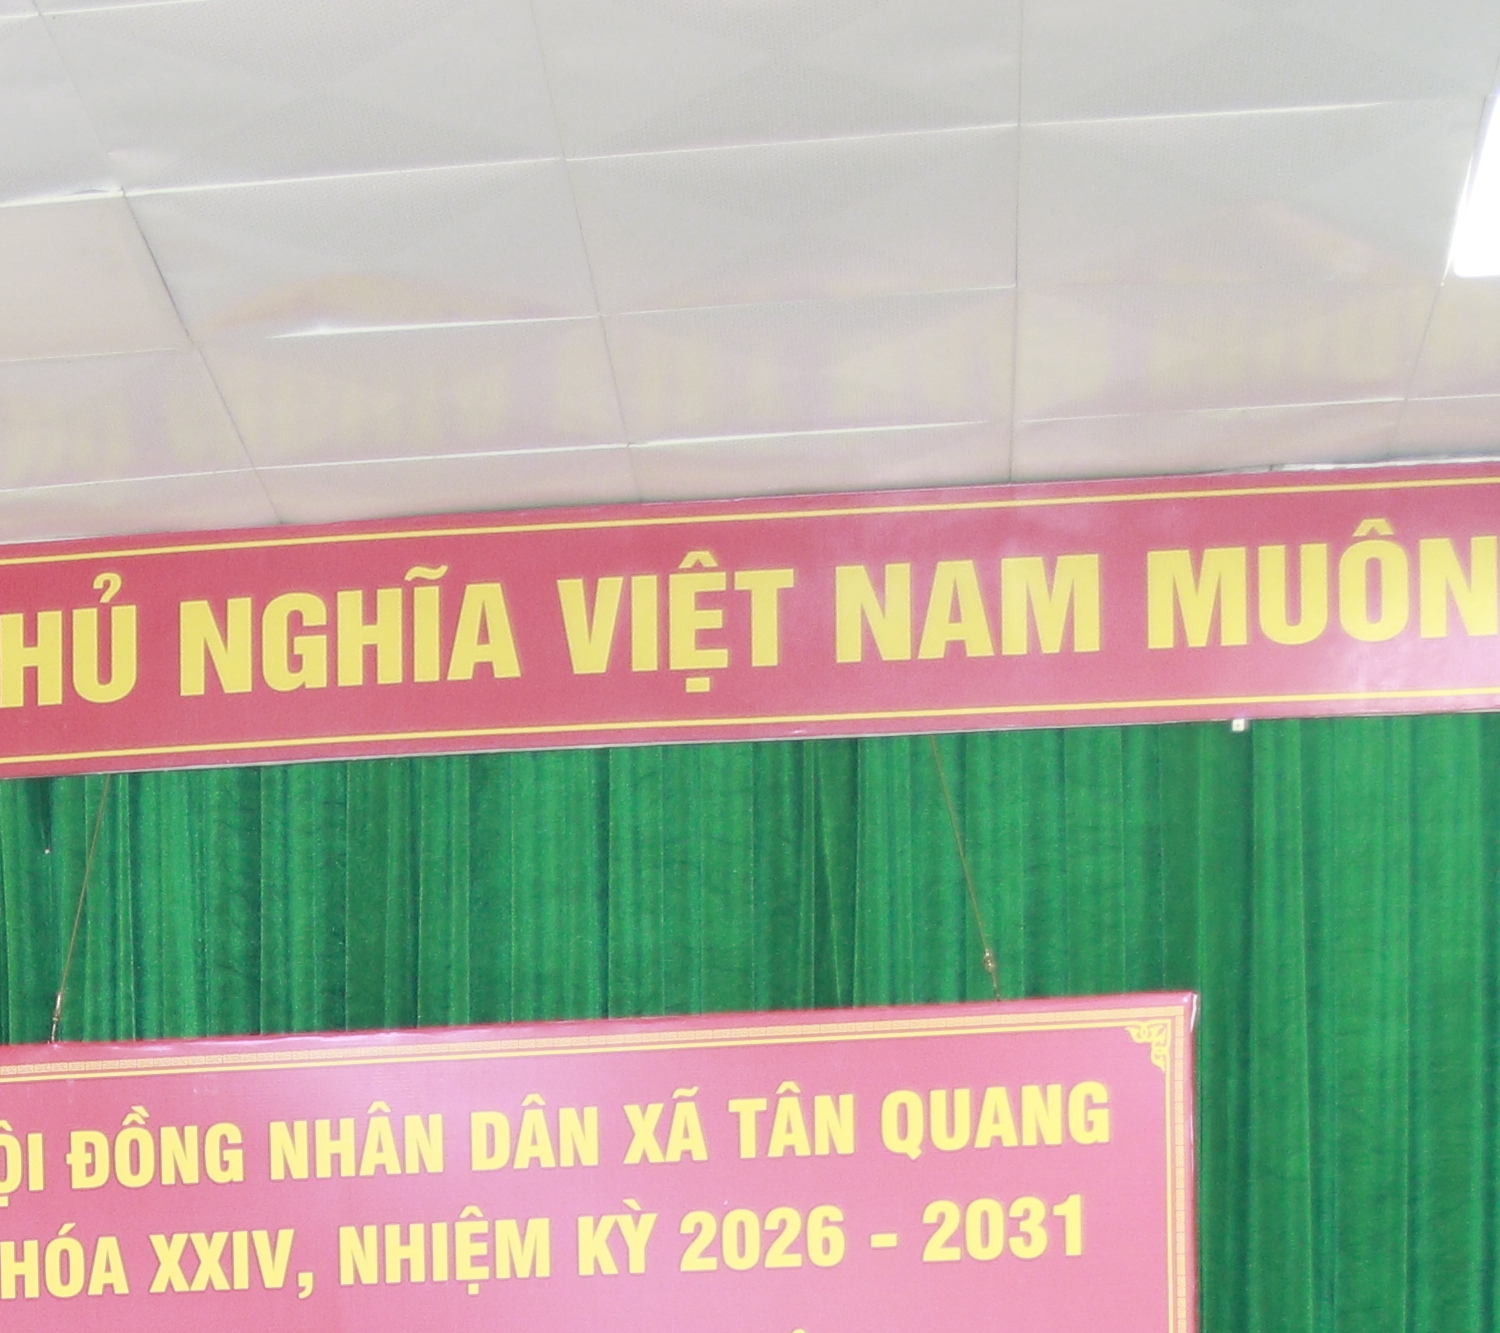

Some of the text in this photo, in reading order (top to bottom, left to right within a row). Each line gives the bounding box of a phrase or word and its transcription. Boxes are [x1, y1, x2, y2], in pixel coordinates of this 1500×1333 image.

[179, 565, 522, 696] NGHĨA
[557, 549, 796, 693] VIỆT
[835, 553, 1103, 663] NAM
[1147, 518, 1500, 650] MUÔN
[67, 1106, 245, 1188] ĐỒNG
[270, 1102, 444, 1179] NHÂN
[472, 1094, 599, 1170] DÂN
[625, 1088, 708, 1163] XÃ
[729, 1081, 856, 1158] TÂN
[881, 1081, 1111, 1158] QUANG
[151, 1229, 314, 1298] XXIV,
[340, 1206, 551, 1294] NHIỆM
[579, 1199, 657, 1275] KỲ
[681, 1205, 846, 1271] 2026
[923, 1195, 1083, 1261] 2031
